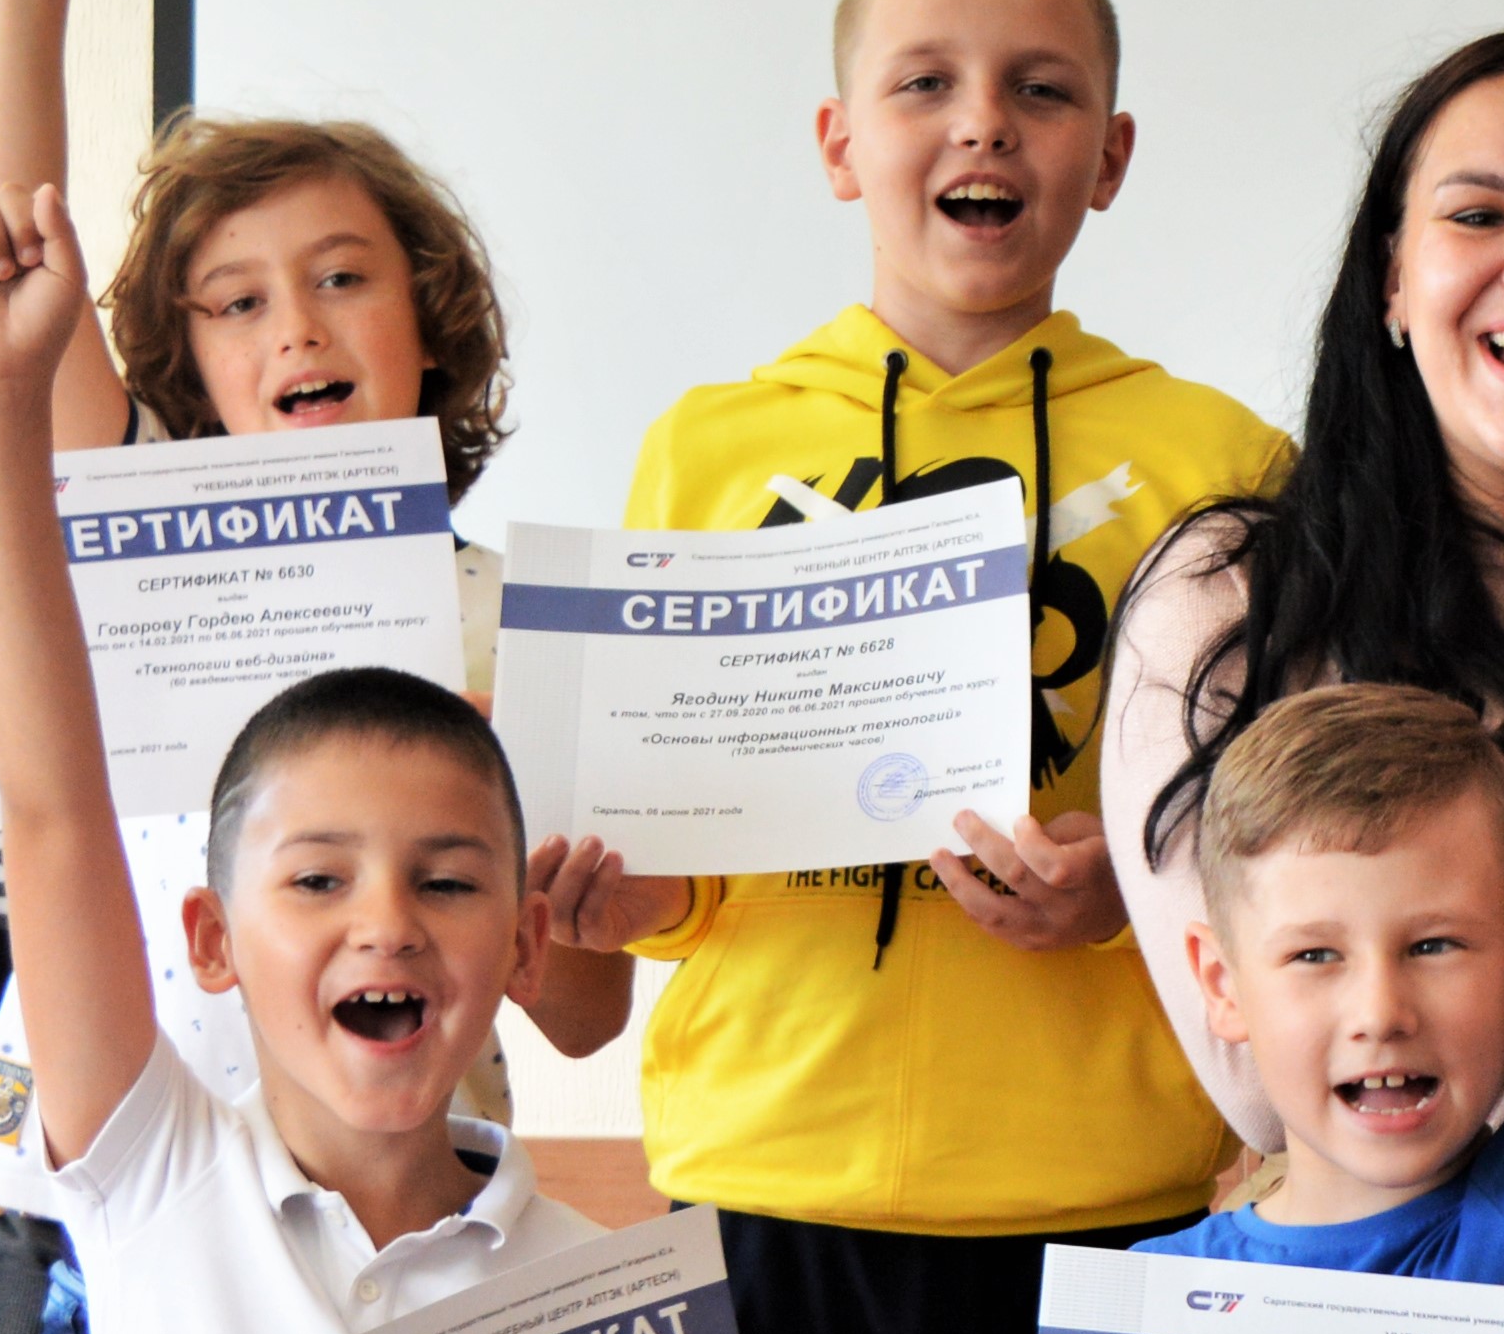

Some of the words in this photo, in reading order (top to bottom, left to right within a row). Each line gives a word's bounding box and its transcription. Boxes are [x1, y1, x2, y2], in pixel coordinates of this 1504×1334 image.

[71, 492, 403, 558] ЕРТИФИКАТ
[138, 570, 249, 592] СЕРТИФИКАТ
[278, 564, 314, 579] 6630
[622, 559, 986, 632] СЕРТИФИКАТ
[98, 620, 182, 637] Говорову
[188, 612, 254, 630] Гордею
[260, 604, 373, 625] Алексеевичу
[720, 647, 832, 667] СЕРТИФИКАТ
[860, 638, 894, 654] 6628
[672, 692, 749, 707] Ягодину
[754, 688, 823, 703] Никите
[829, 671, 946, 696] Максимовичу
[718, 725, 857, 744] информационных
